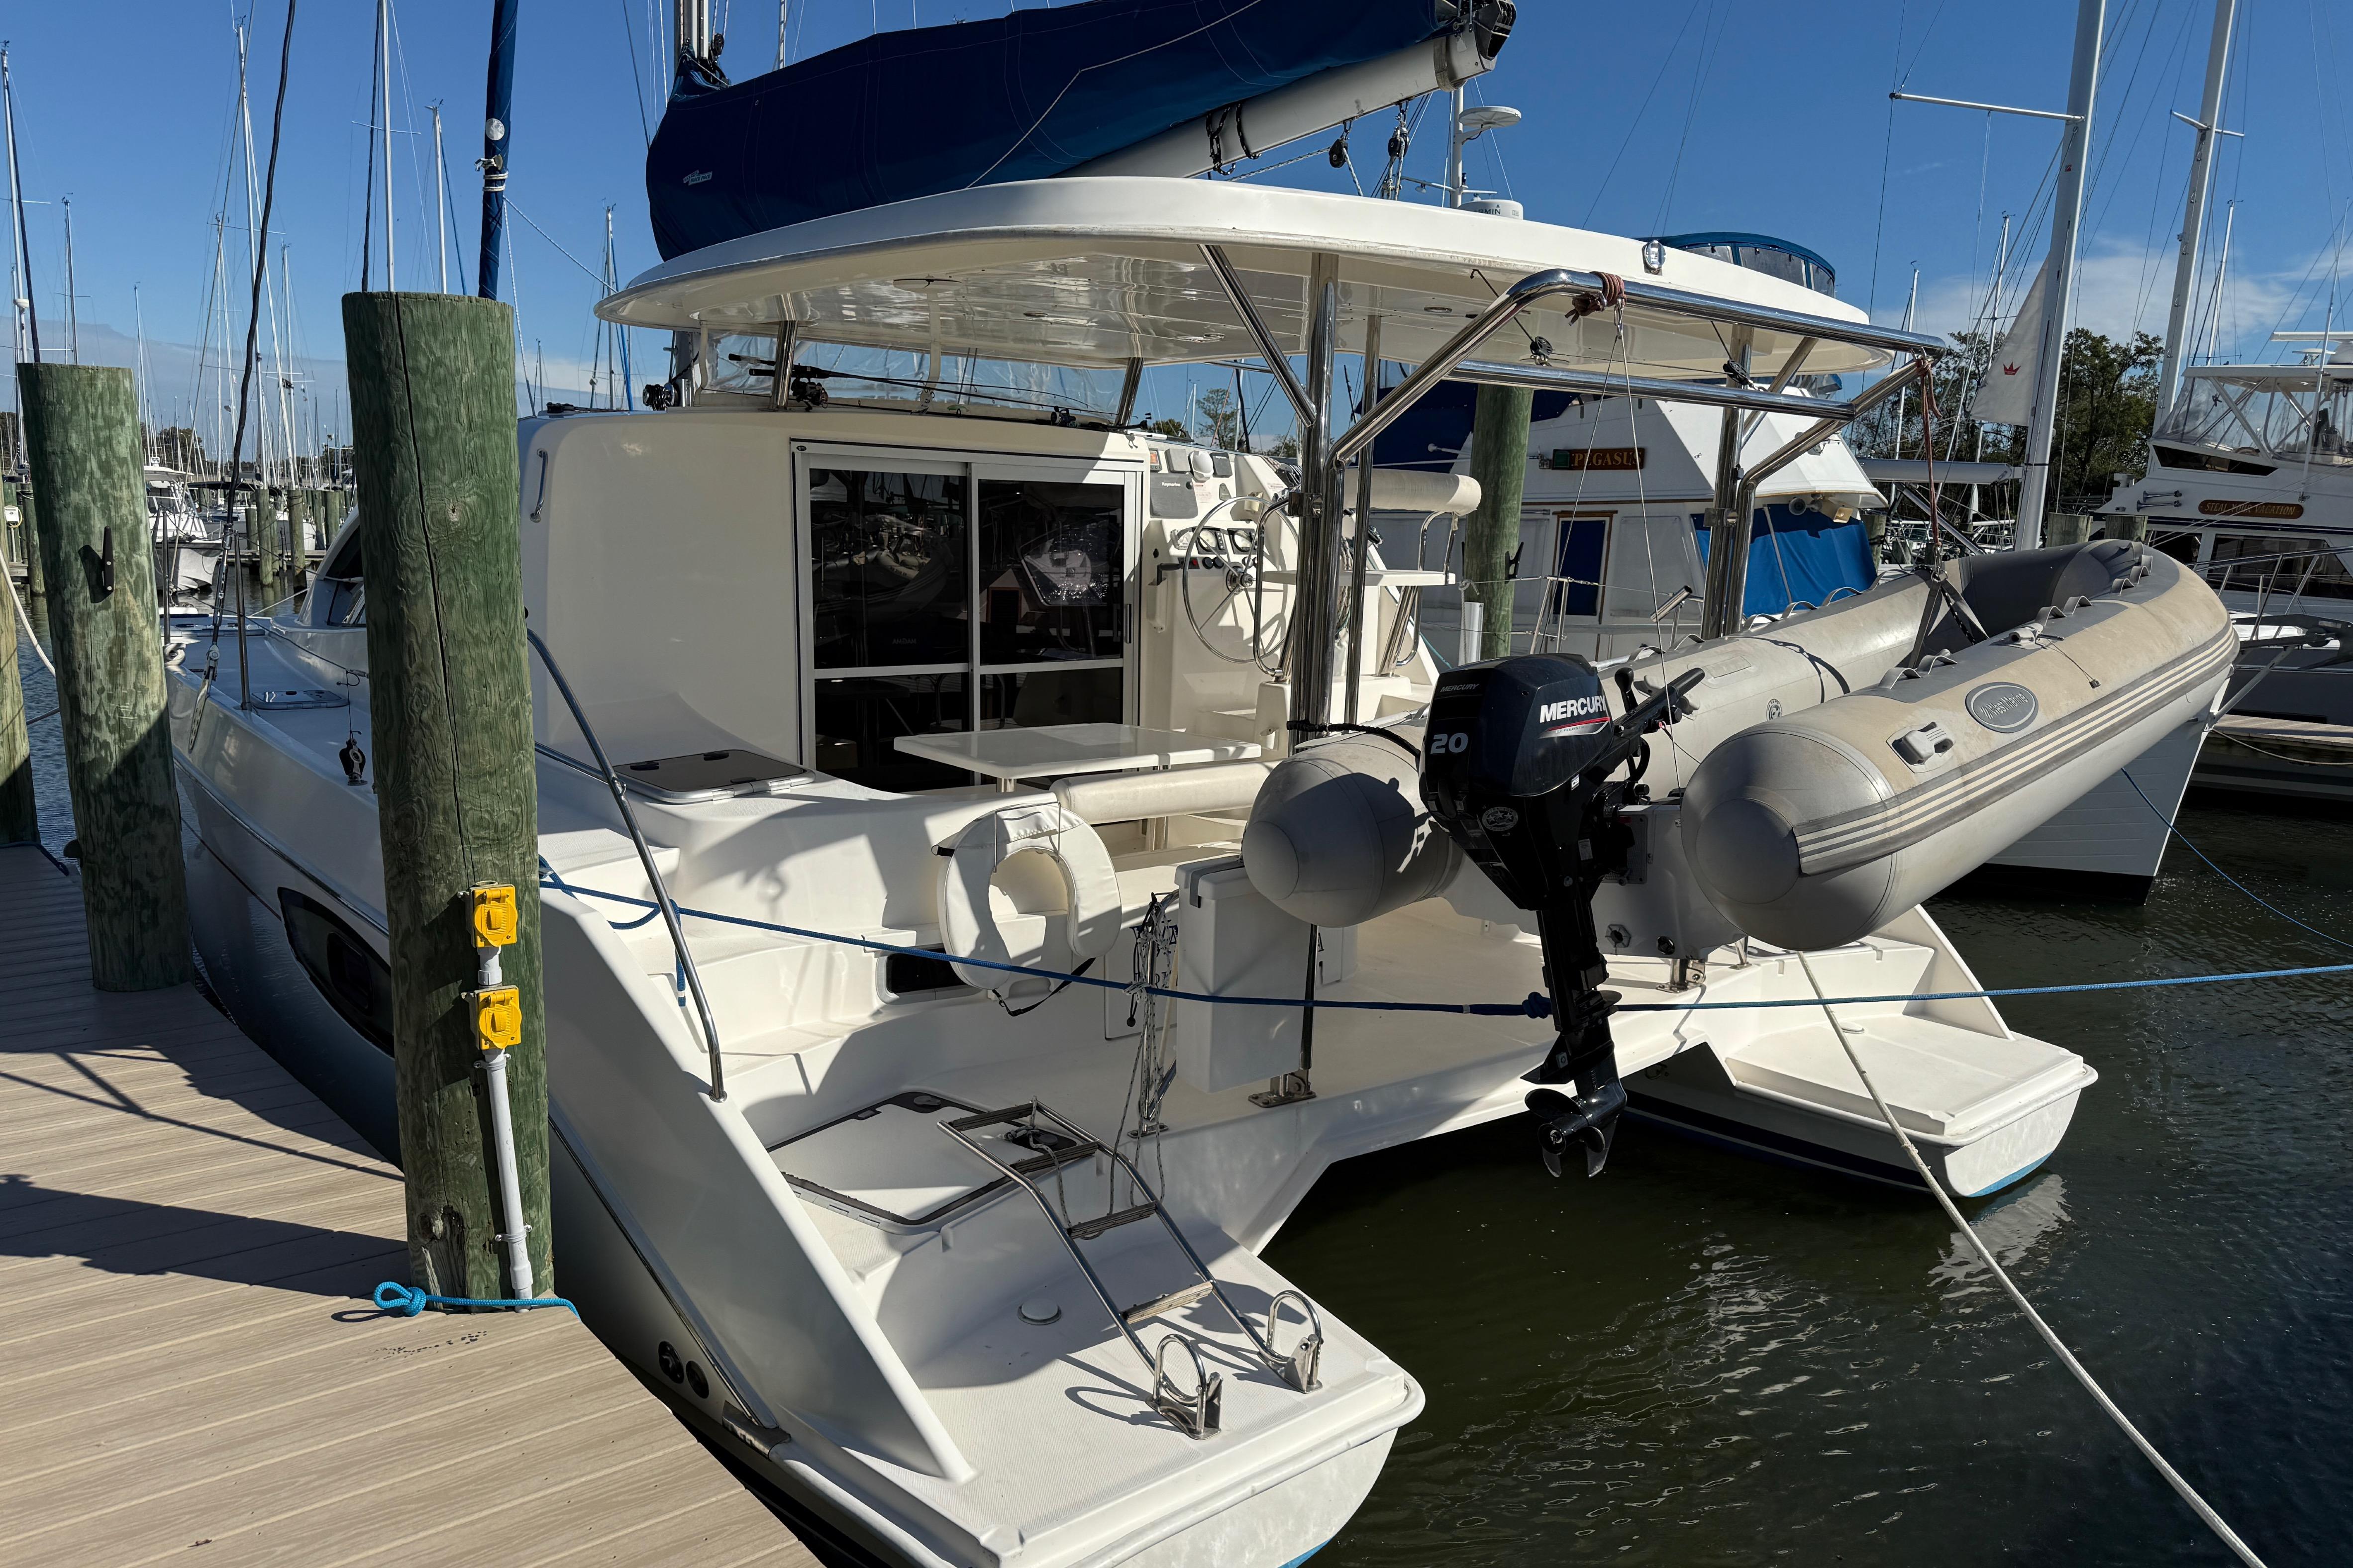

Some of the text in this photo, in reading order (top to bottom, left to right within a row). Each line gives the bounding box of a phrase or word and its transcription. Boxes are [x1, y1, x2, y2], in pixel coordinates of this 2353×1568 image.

[1574, 452, 1641, 466] PEGASUS
[2205, 502, 2296, 515] STEAL YOUR VACATION
[1439, 684, 1480, 692] MERCURY
[1539, 695, 1606, 723] MERCURY
[1985, 692, 2029, 716] West Marine
[1430, 732, 1468, 754] 20
